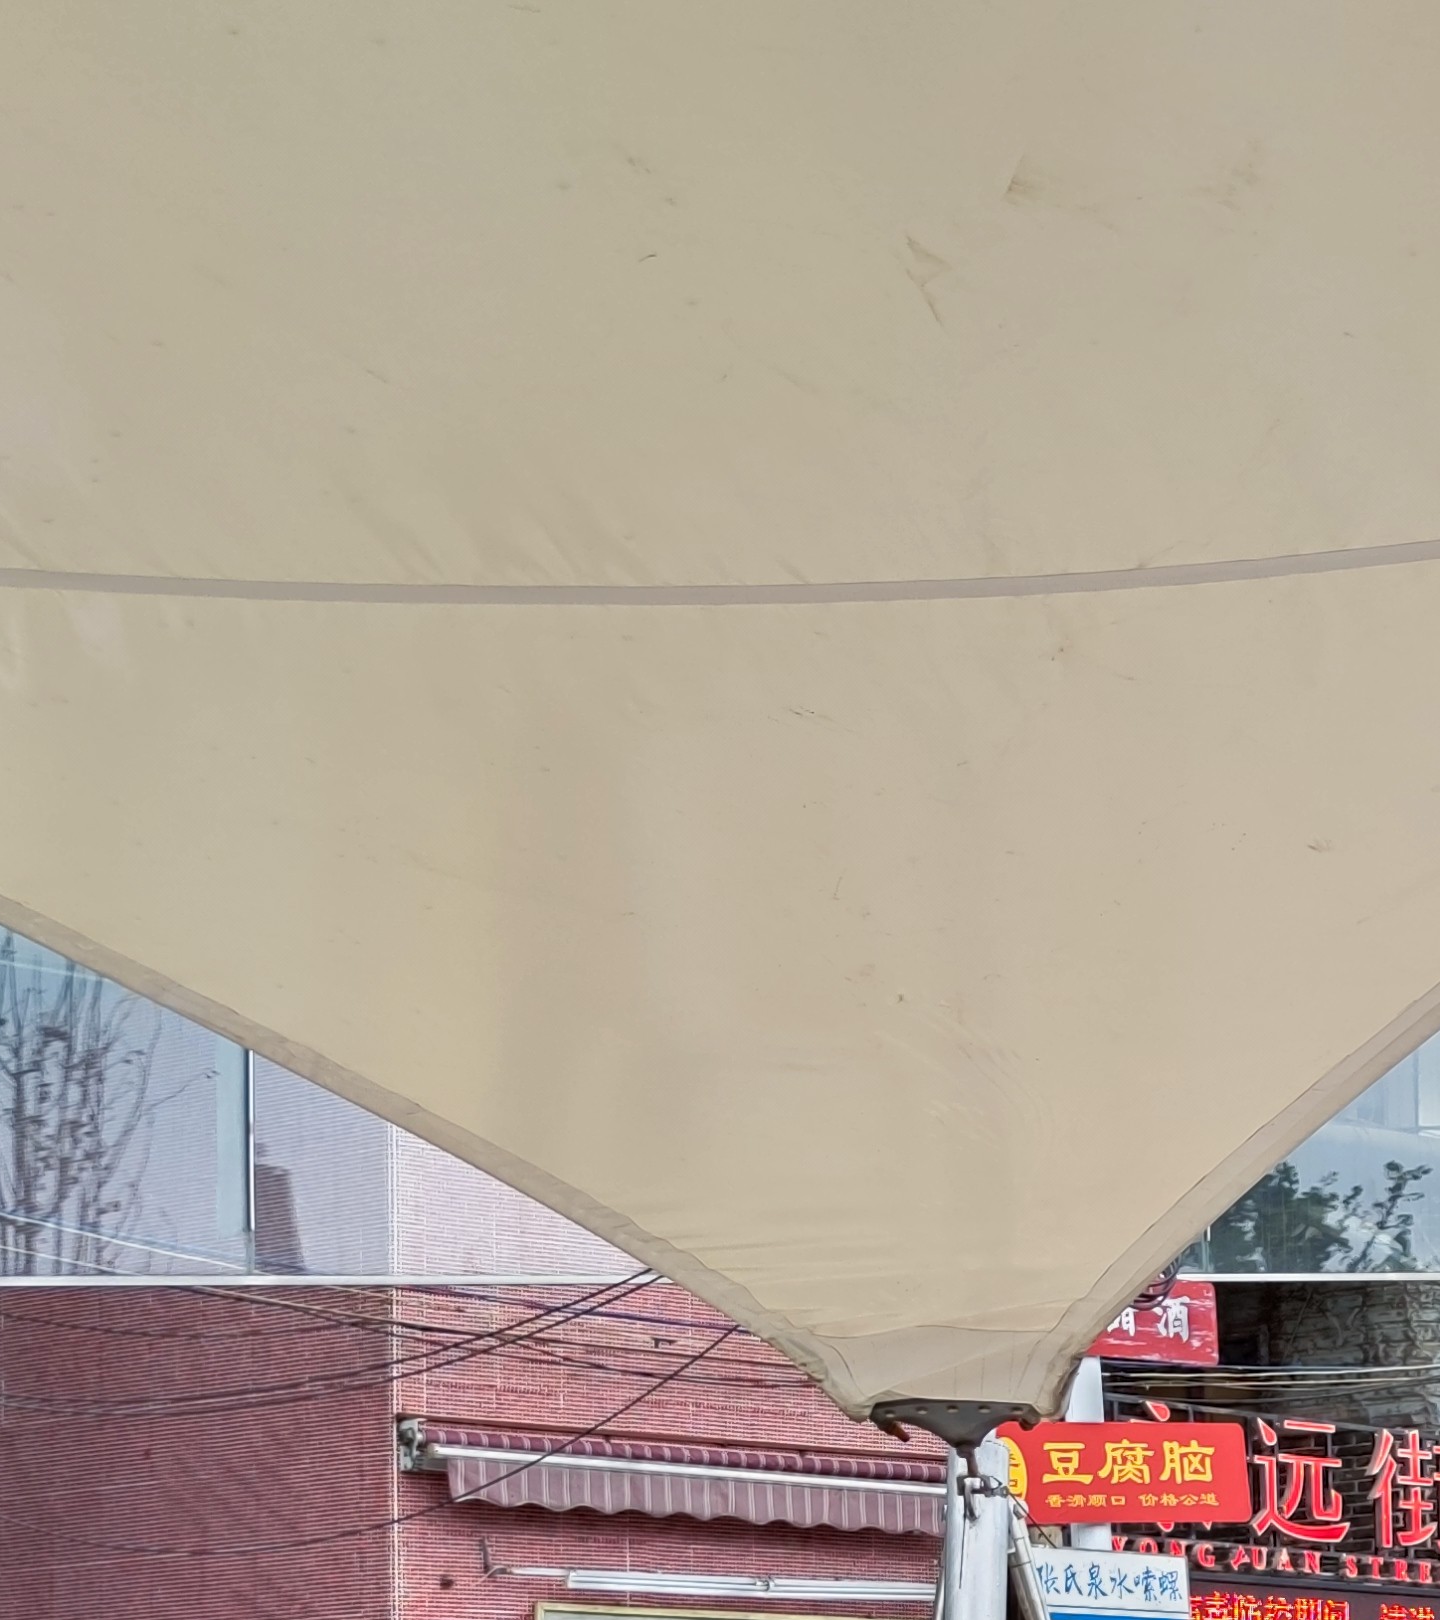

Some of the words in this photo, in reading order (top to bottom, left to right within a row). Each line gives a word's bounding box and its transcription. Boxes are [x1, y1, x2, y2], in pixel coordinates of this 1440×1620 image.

[1041, 1439, 1216, 1485] 豆腐脑
[1044, 1494, 1127, 1508] 香滑顺口
[1138, 1494, 1220, 1508] 价格公道
